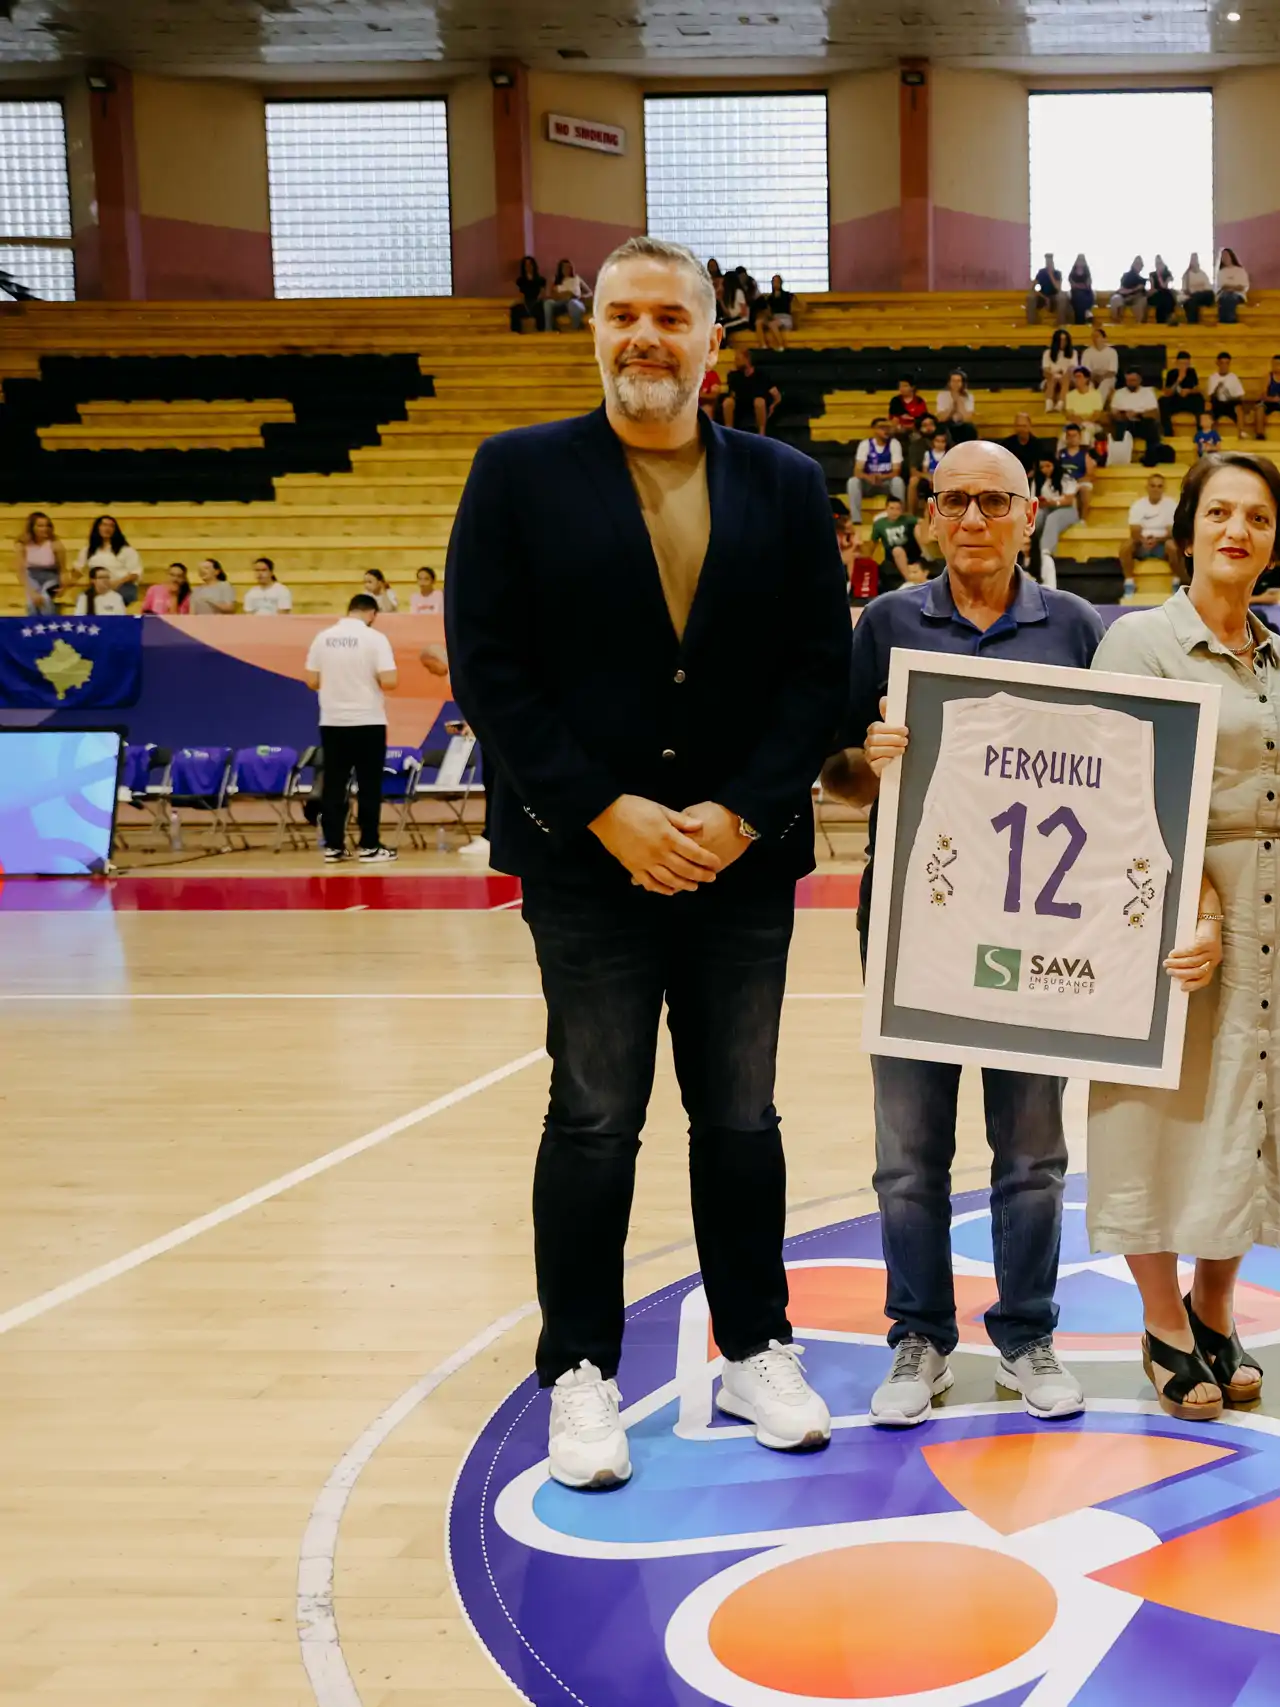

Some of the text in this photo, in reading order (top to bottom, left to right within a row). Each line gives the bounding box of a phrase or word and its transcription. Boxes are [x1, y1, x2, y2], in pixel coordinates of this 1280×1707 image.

[554, 122, 619, 146] NO SMOKING
[984, 744, 1102, 789] PERQUKU
[990, 801, 1087, 919] 12
[1030, 954, 1095, 980] SAVA
[1028, 982, 1095, 995] GROUP
[1029, 976, 1095, 989] INSURANCE
